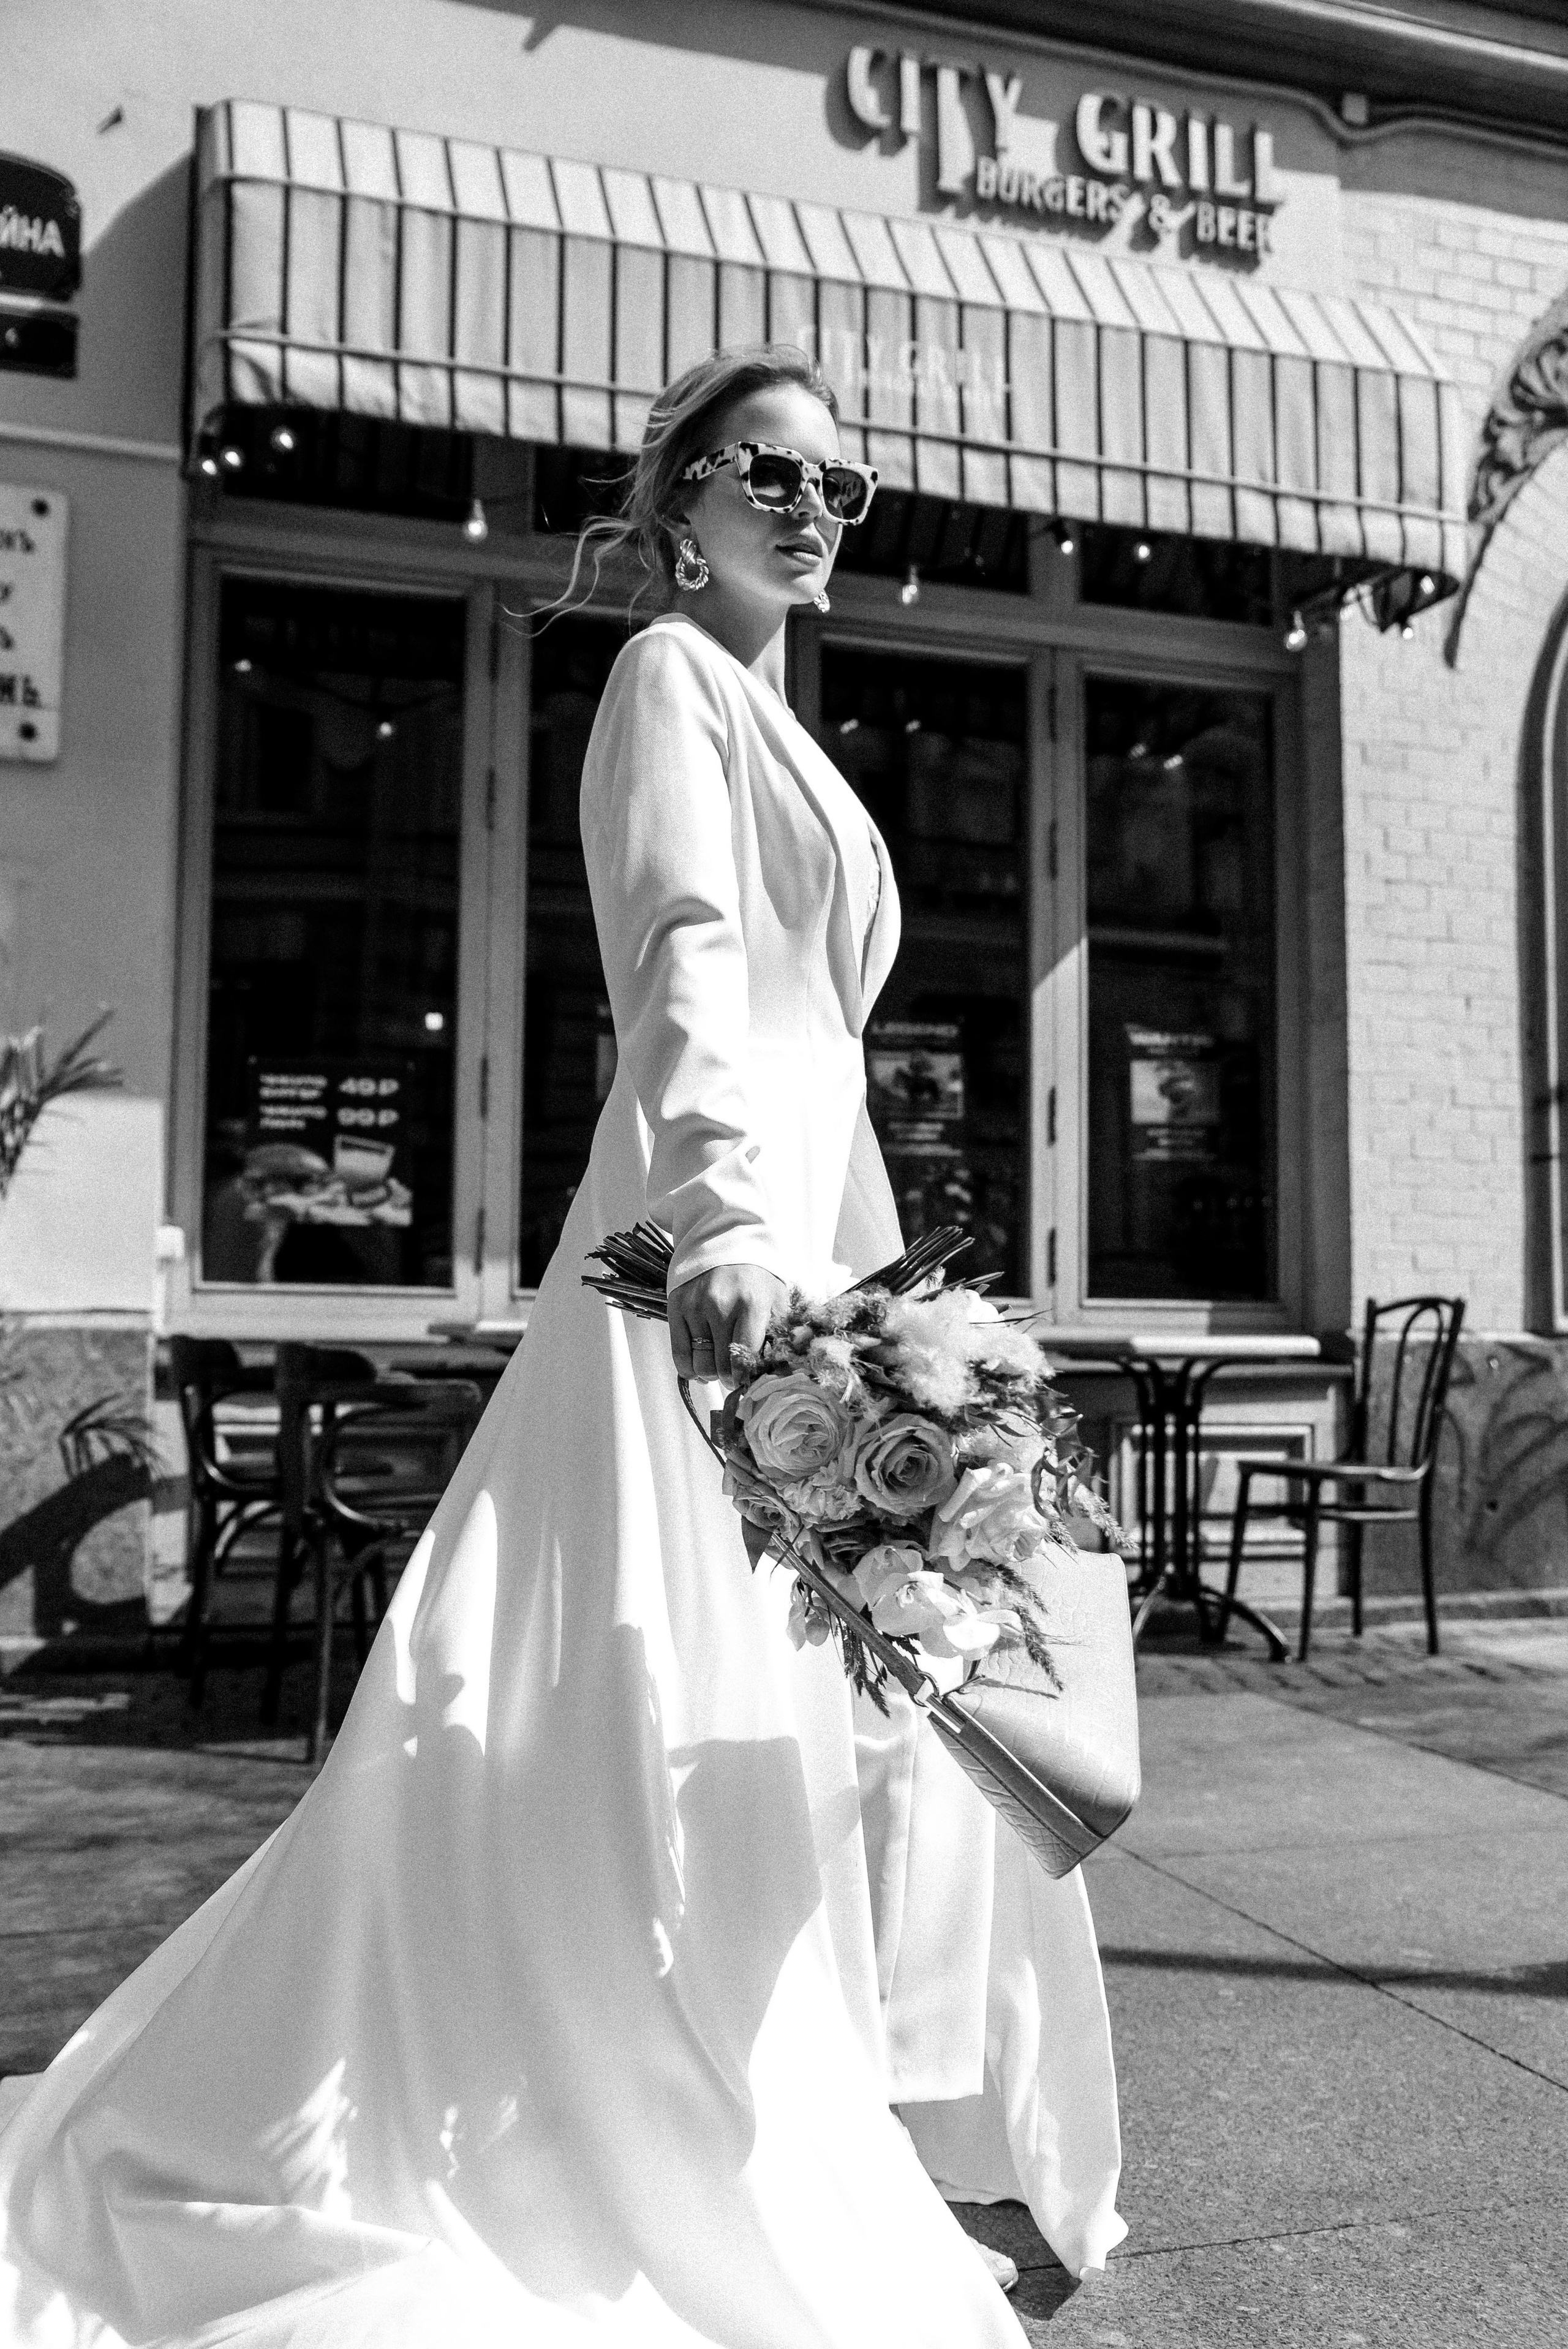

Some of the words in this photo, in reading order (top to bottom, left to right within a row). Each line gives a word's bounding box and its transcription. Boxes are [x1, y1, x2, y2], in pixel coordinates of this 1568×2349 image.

[847, 44, 1022, 192] CITY
[1076, 92, 1286, 203] GRILL
[977, 154, 1131, 223] BURGERS
[1196, 200, 1274, 254] BEER
